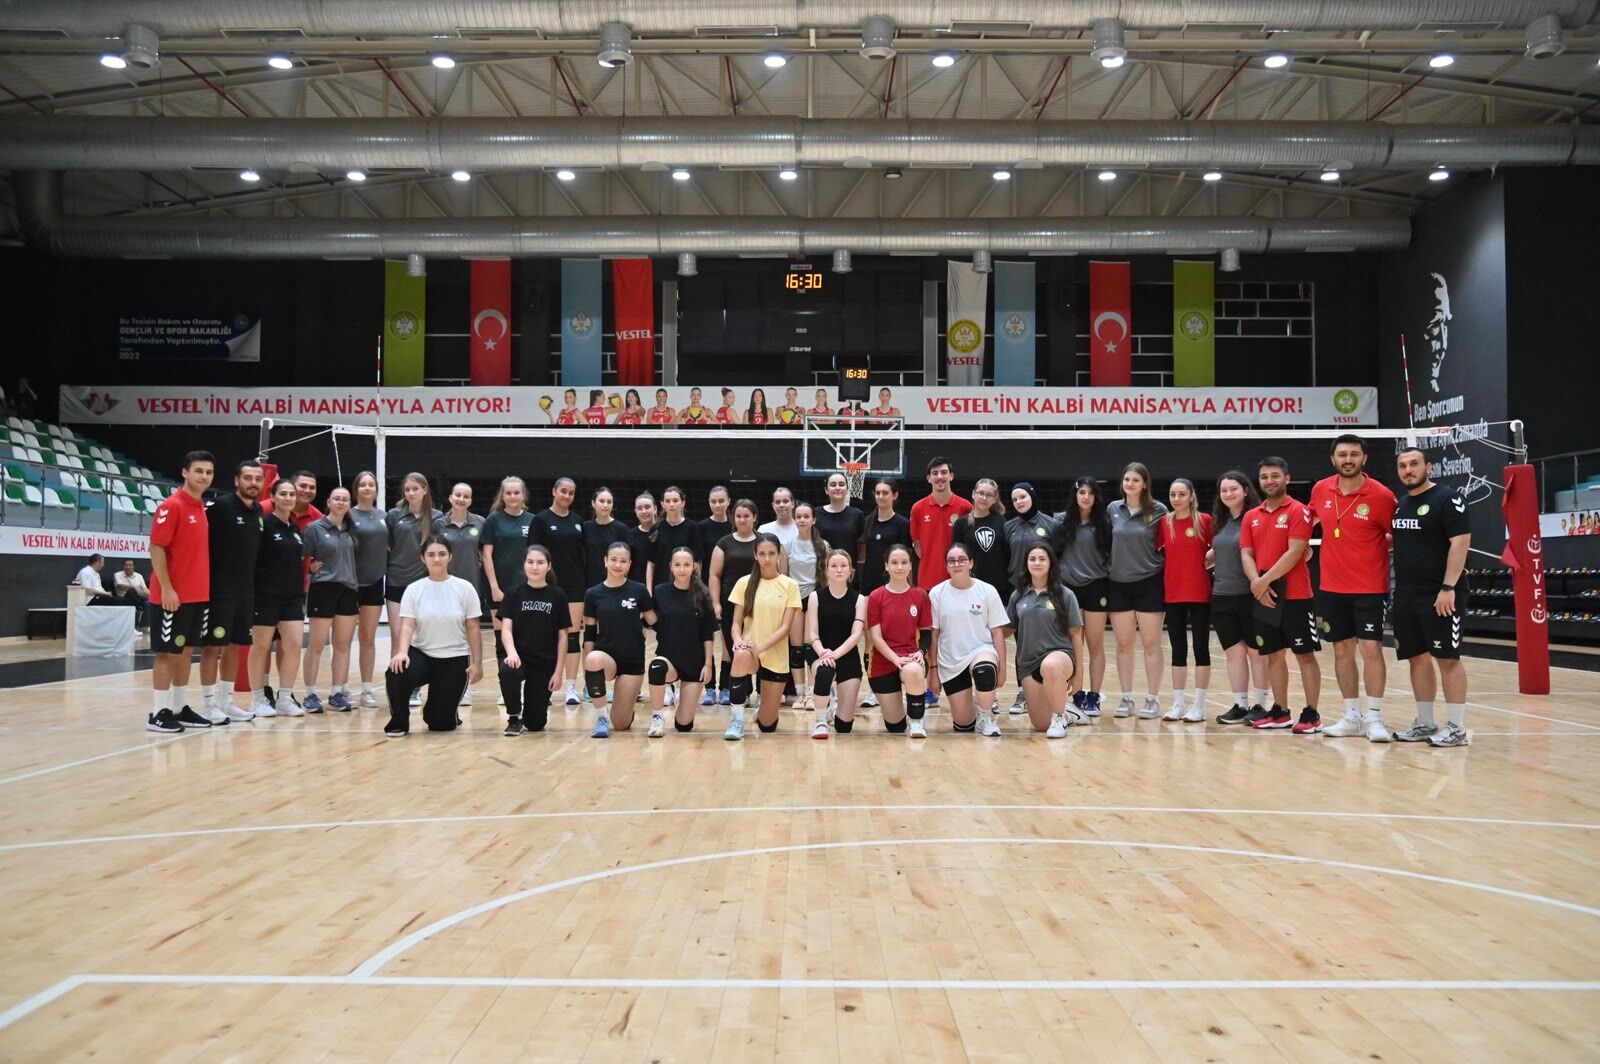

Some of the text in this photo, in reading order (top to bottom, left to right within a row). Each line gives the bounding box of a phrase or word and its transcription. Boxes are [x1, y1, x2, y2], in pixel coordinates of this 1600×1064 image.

[786, 273, 822, 289] 16:30
[154, 327, 165, 335] VE
[166, 327, 188, 335] SPOR
[616, 329, 654, 341] VESTEL
[946, 356, 983, 367] VESTEL
[846, 369, 868, 379] 16:30
[237, 394, 292, 414] KALBİ
[299, 394, 424, 414] MANİSA'YLA
[430, 396, 511, 414] ATIYOR!
[1027, 394, 1084, 414] KALBİ
[1090, 393, 1217, 414] MANİSA'YLA
[1223, 396, 1303, 414] ATIYOR!
[1413, 395, 1464, 423] Ben Sporcunun
[1392, 518, 1422, 530] VESTEL
[71, 534, 95, 550] KALBİ
[97, 536, 146, 553] MANİSA'YLA
[977, 530, 993, 548] NG
